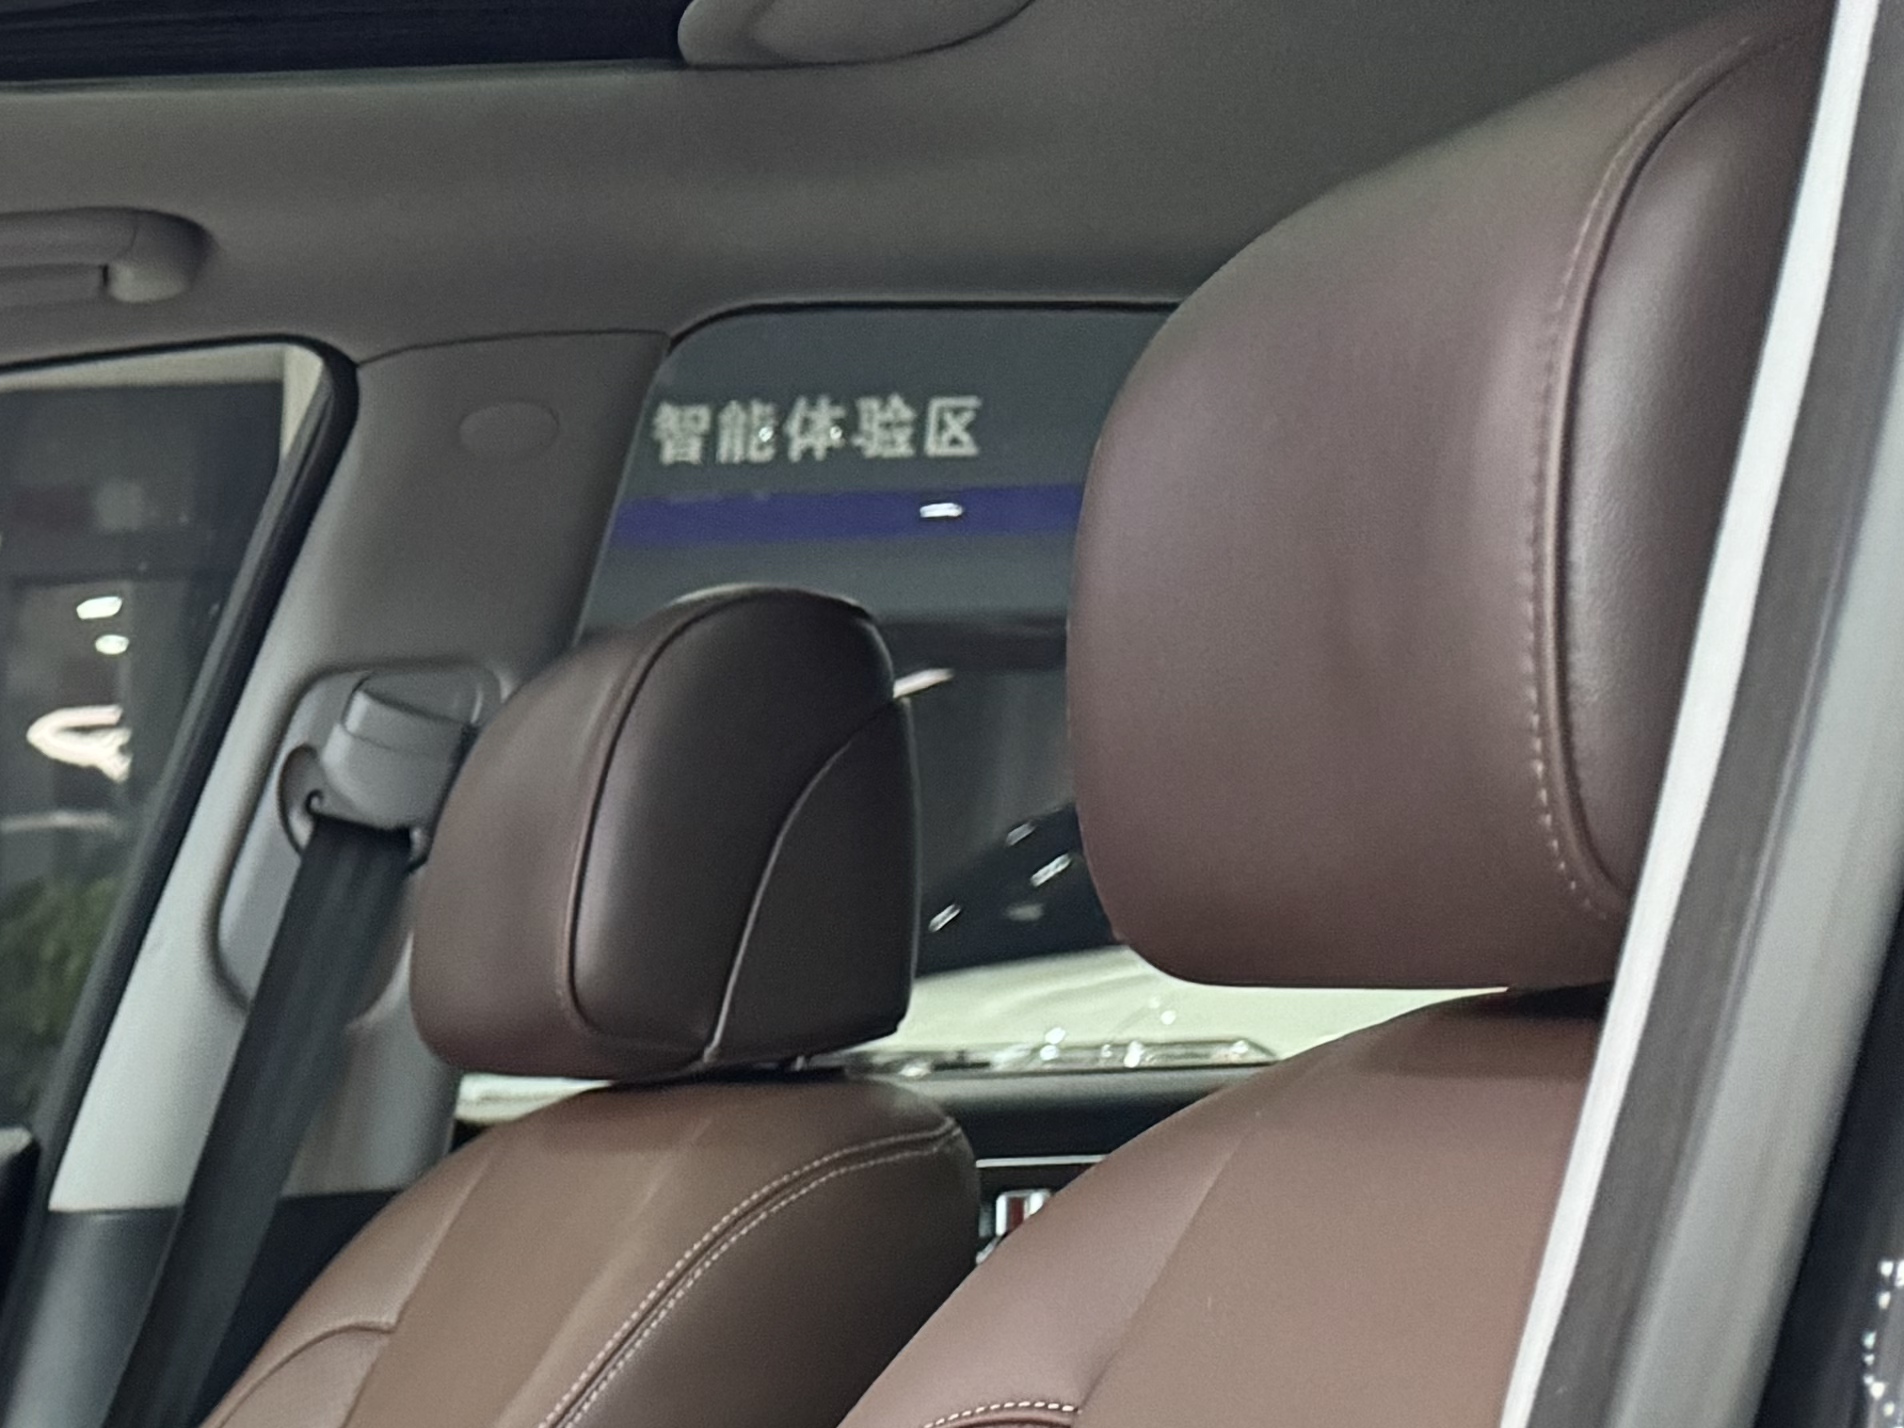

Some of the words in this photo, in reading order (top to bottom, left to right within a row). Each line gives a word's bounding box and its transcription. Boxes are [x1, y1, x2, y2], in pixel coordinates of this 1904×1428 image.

[653, 394, 982, 465] 智能体验区
